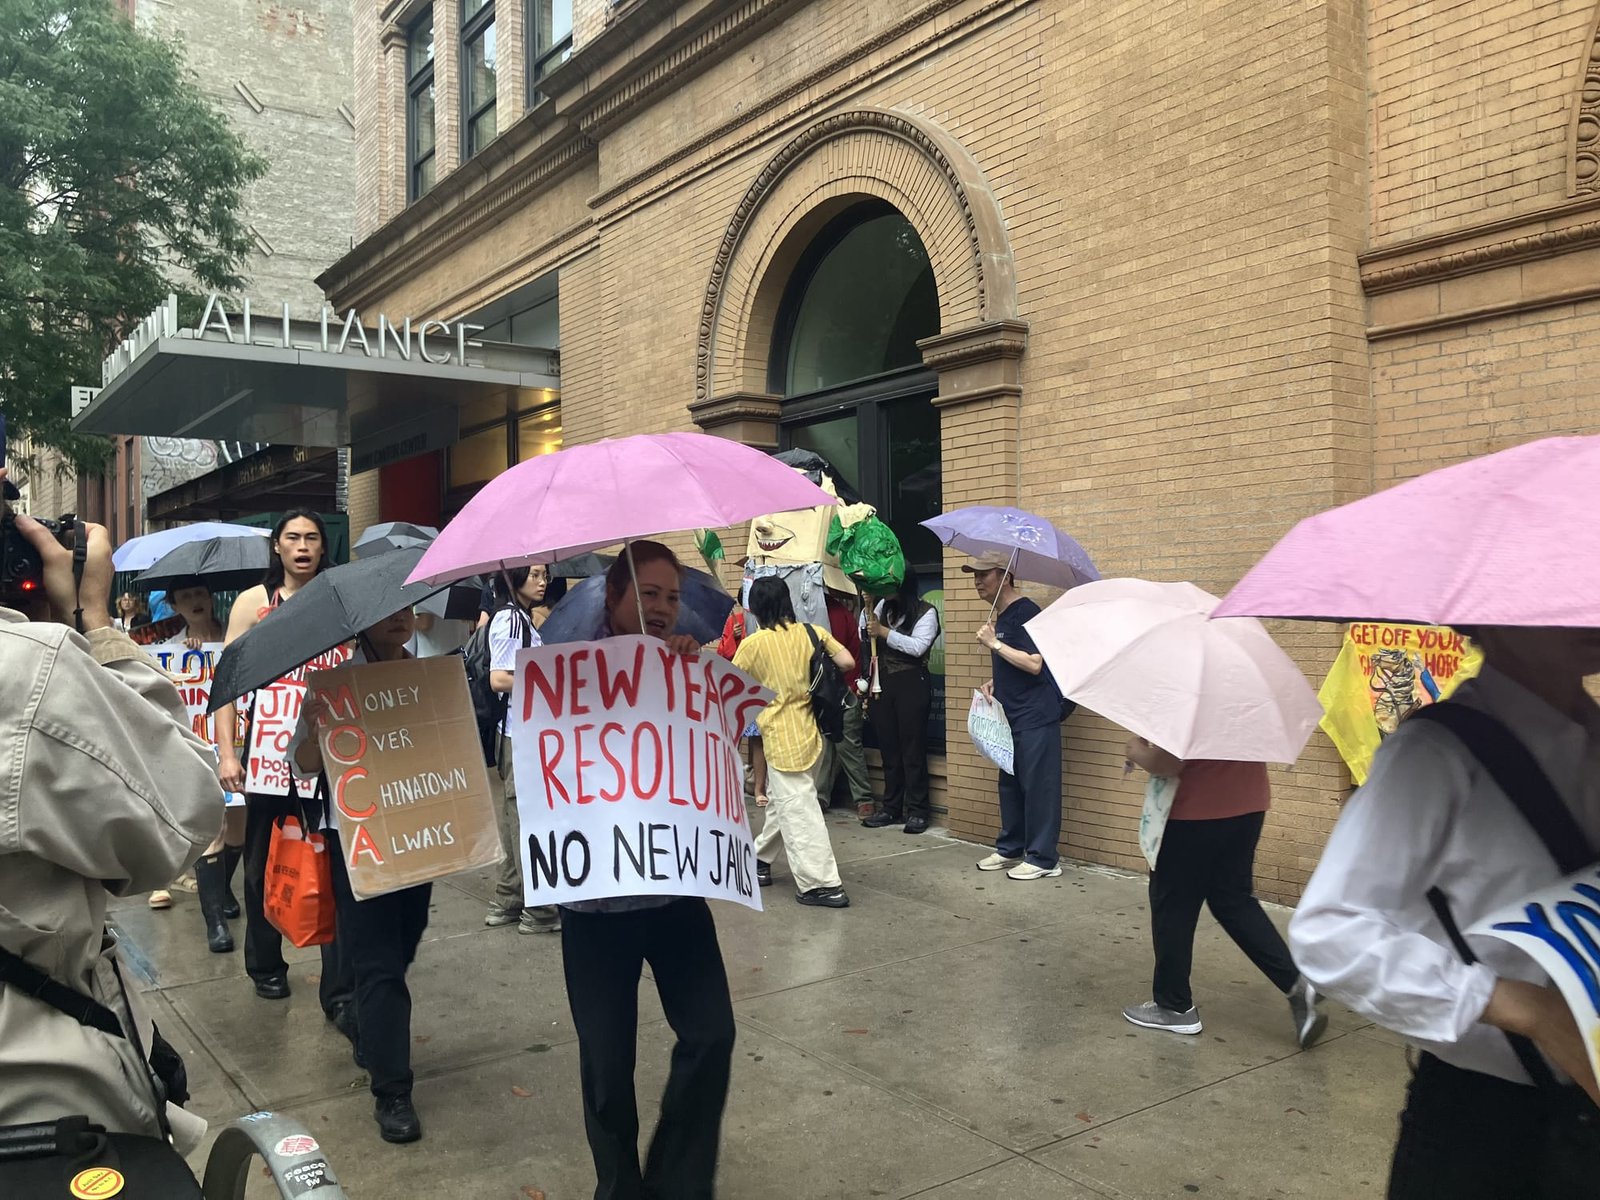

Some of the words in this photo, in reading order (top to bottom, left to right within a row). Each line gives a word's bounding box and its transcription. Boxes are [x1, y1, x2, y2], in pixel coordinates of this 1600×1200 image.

[198, 293, 485, 369] ALLIANCE
[1350, 623, 1380, 645] GET
[1382, 627, 1412, 646] OFF
[1416, 628, 1466, 655] YOUR
[523, 642, 645, 722] NEW
[335, 766, 468, 822] CHINATOWN
[350, 823, 456, 871] ALWAYS
[528, 829, 591, 891] NO
[613, 821, 699, 883] NEW
[709, 829, 754, 899] JAILS
